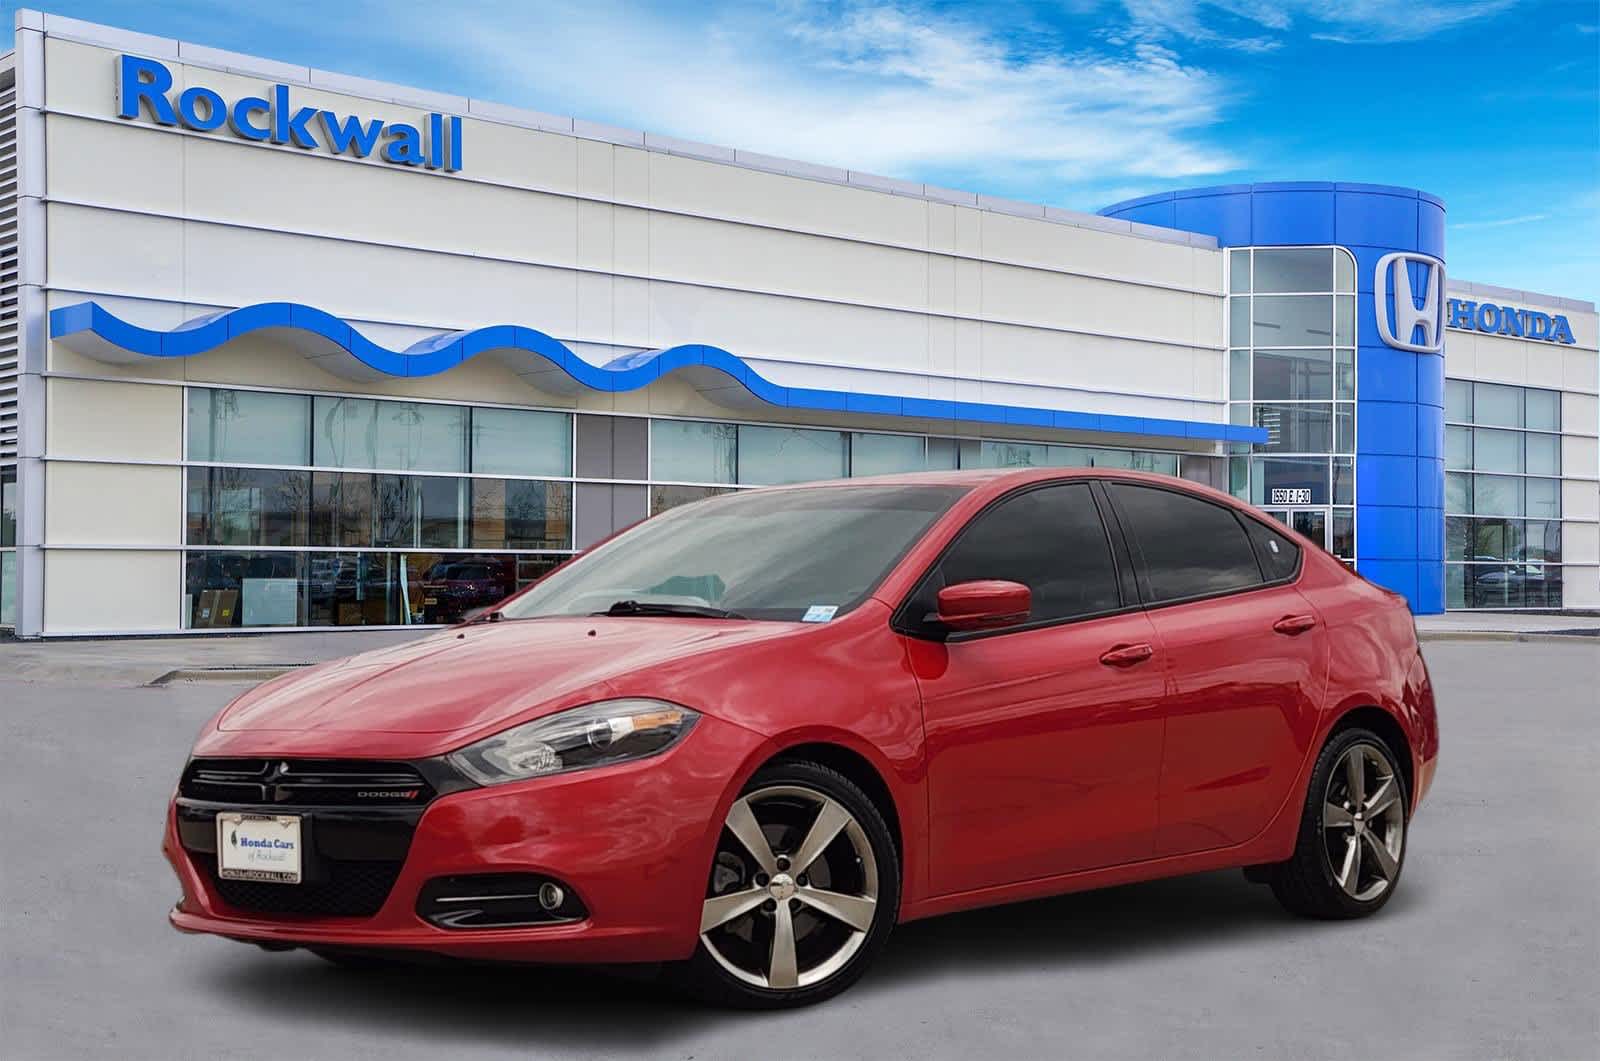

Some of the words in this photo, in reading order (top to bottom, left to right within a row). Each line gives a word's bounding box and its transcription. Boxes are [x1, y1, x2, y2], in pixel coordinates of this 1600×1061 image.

[118, 54, 462, 172] Rockwall
[1447, 298, 1577, 344] HONDA
[240, 837, 272, 849] Honda
[273, 838, 294, 849] Cars
